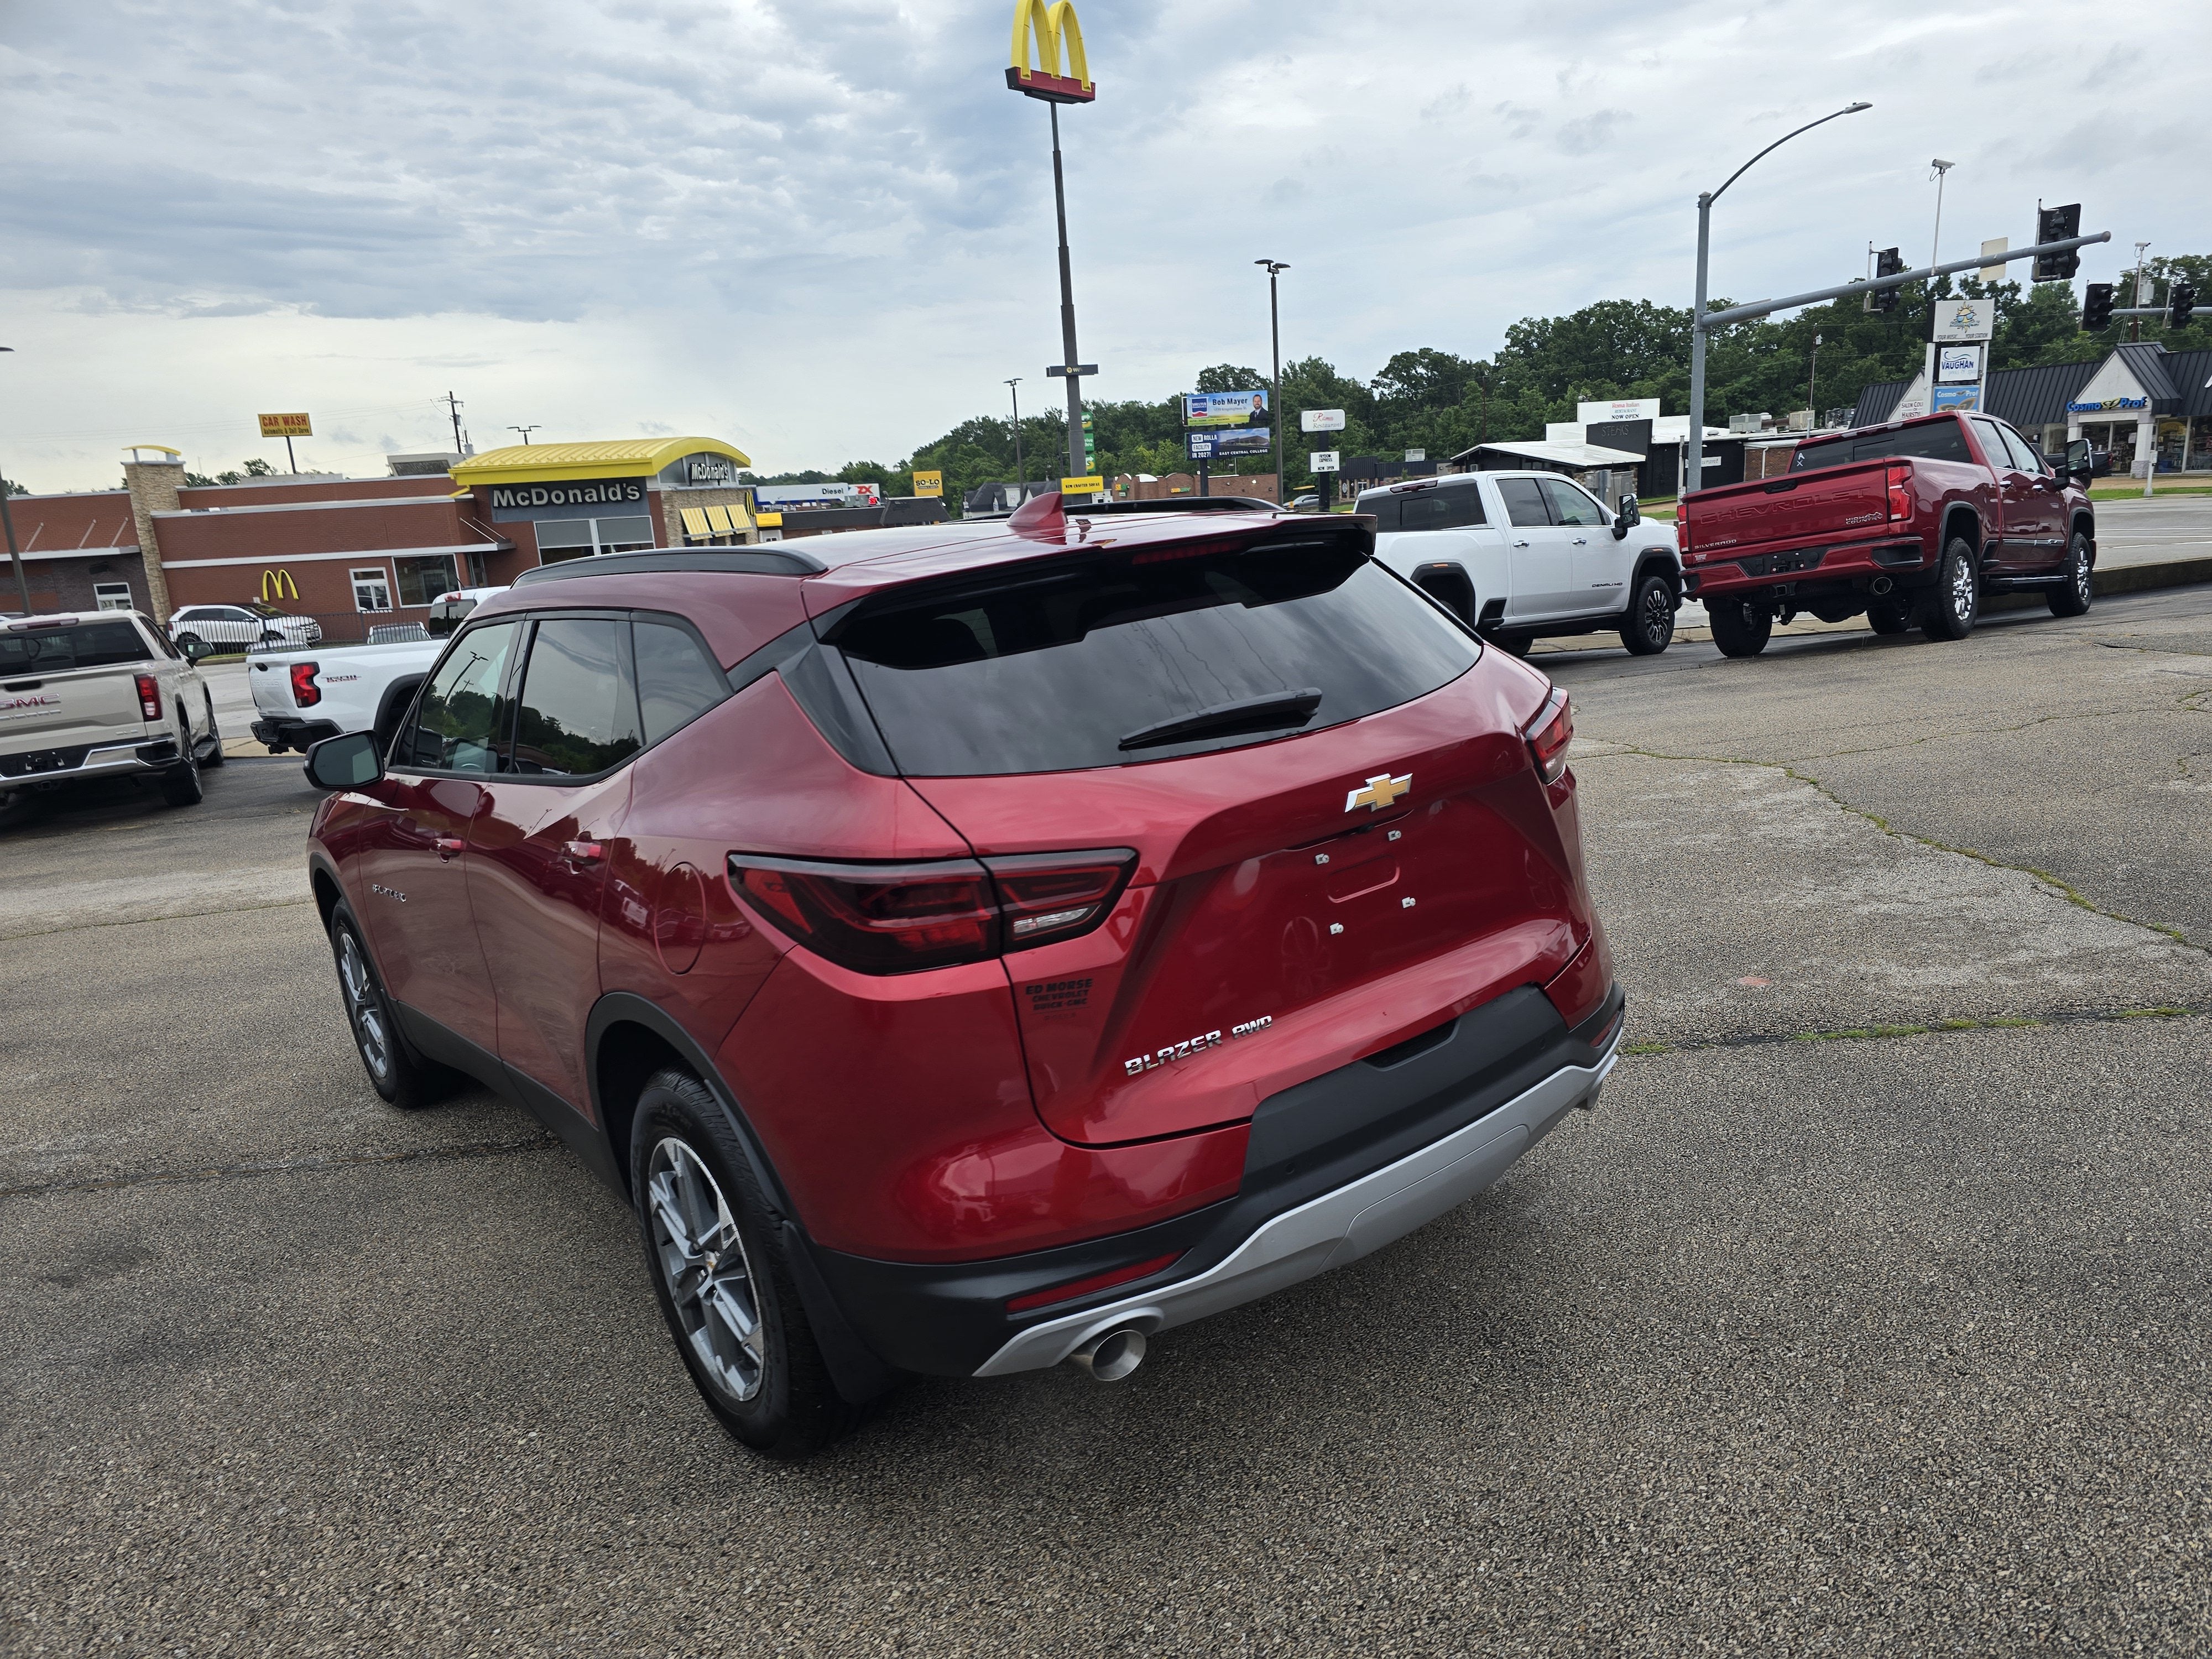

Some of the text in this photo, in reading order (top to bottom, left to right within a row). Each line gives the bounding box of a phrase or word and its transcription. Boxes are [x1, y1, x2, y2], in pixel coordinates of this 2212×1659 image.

[1942, 360, 1974, 369] VAUGHAN
[2067, 397, 2148, 411] Cosmo Prof
[262, 415, 307, 426] CAR WASH
[1601, 425, 1629, 436] STEAKS
[692, 462, 728, 481] McDonald's
[493, 483, 641, 508] McDonald's
[1700, 487, 1872, 525] CHEVROLET
[1694, 539, 1736, 549] SILVERADO
[1026, 978, 1093, 995] ED MORSE
[1032, 989, 1089, 1003] CHEVROLET
[1125, 1015, 1273, 1076] BLAZER AWD
